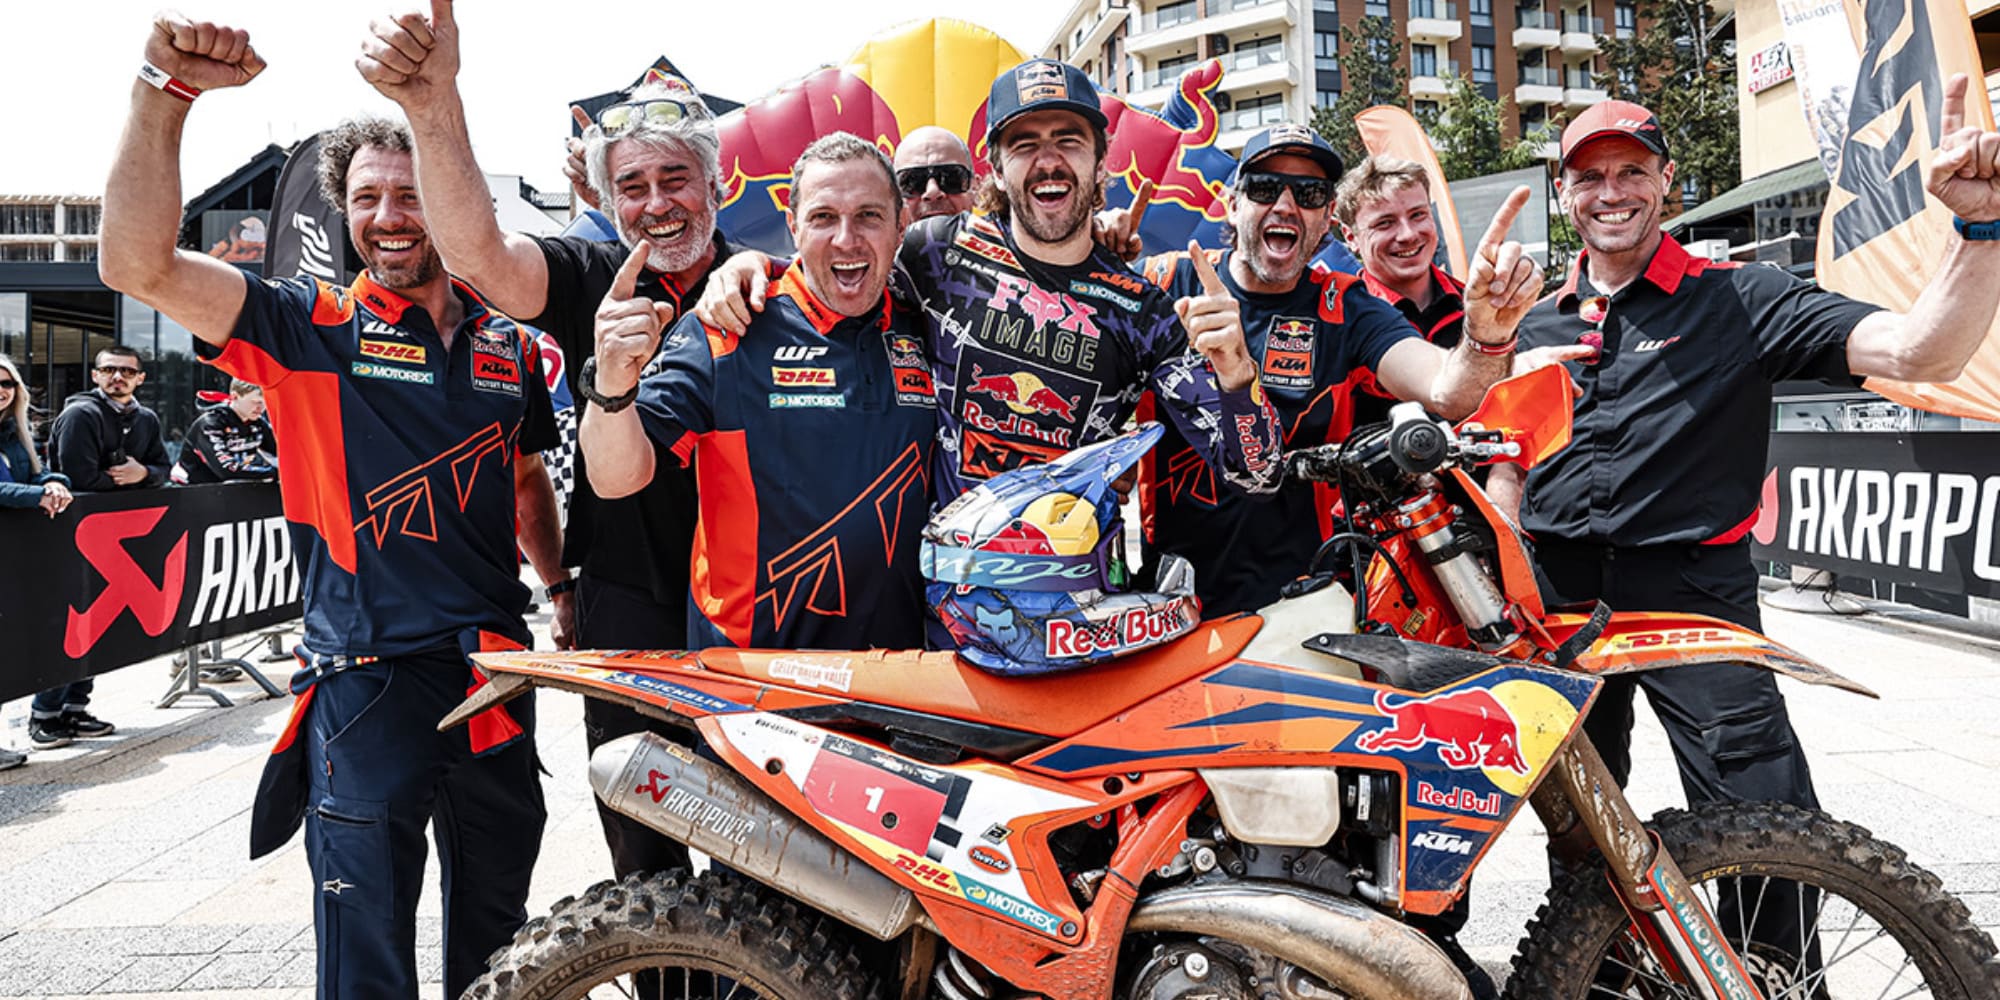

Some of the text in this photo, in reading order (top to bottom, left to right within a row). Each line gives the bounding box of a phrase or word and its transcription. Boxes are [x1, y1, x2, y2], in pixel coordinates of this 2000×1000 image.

[964, 236, 1018, 266] DHL
[1089, 285, 1138, 313] MOTOREX
[361, 343, 426, 361] DHL
[773, 346, 829, 361] WP
[980, 309, 1099, 371] IMAGE
[372, 365, 432, 383] MOTOREX
[480, 361, 513, 377] KTM
[776, 371, 831, 383] DHL
[1270, 357, 1307, 371] KTM
[902, 373, 928, 389] KTM
[788, 394, 842, 406] MOTOREX
[963, 399, 1072, 448] Red Bull
[1234, 414, 1268, 472] Red Bull
[1046, 596, 1184, 657] Red Bull
[1625, 630, 1735, 649] DHL
[639, 679, 727, 709] MICHELIN
[864, 785, 885, 814] 1
[1416, 782, 1501, 816] Red Bull
[1411, 830, 1474, 856] KTM
[893, 853, 951, 889] DHL
[985, 890, 1058, 933] MOTOREX
